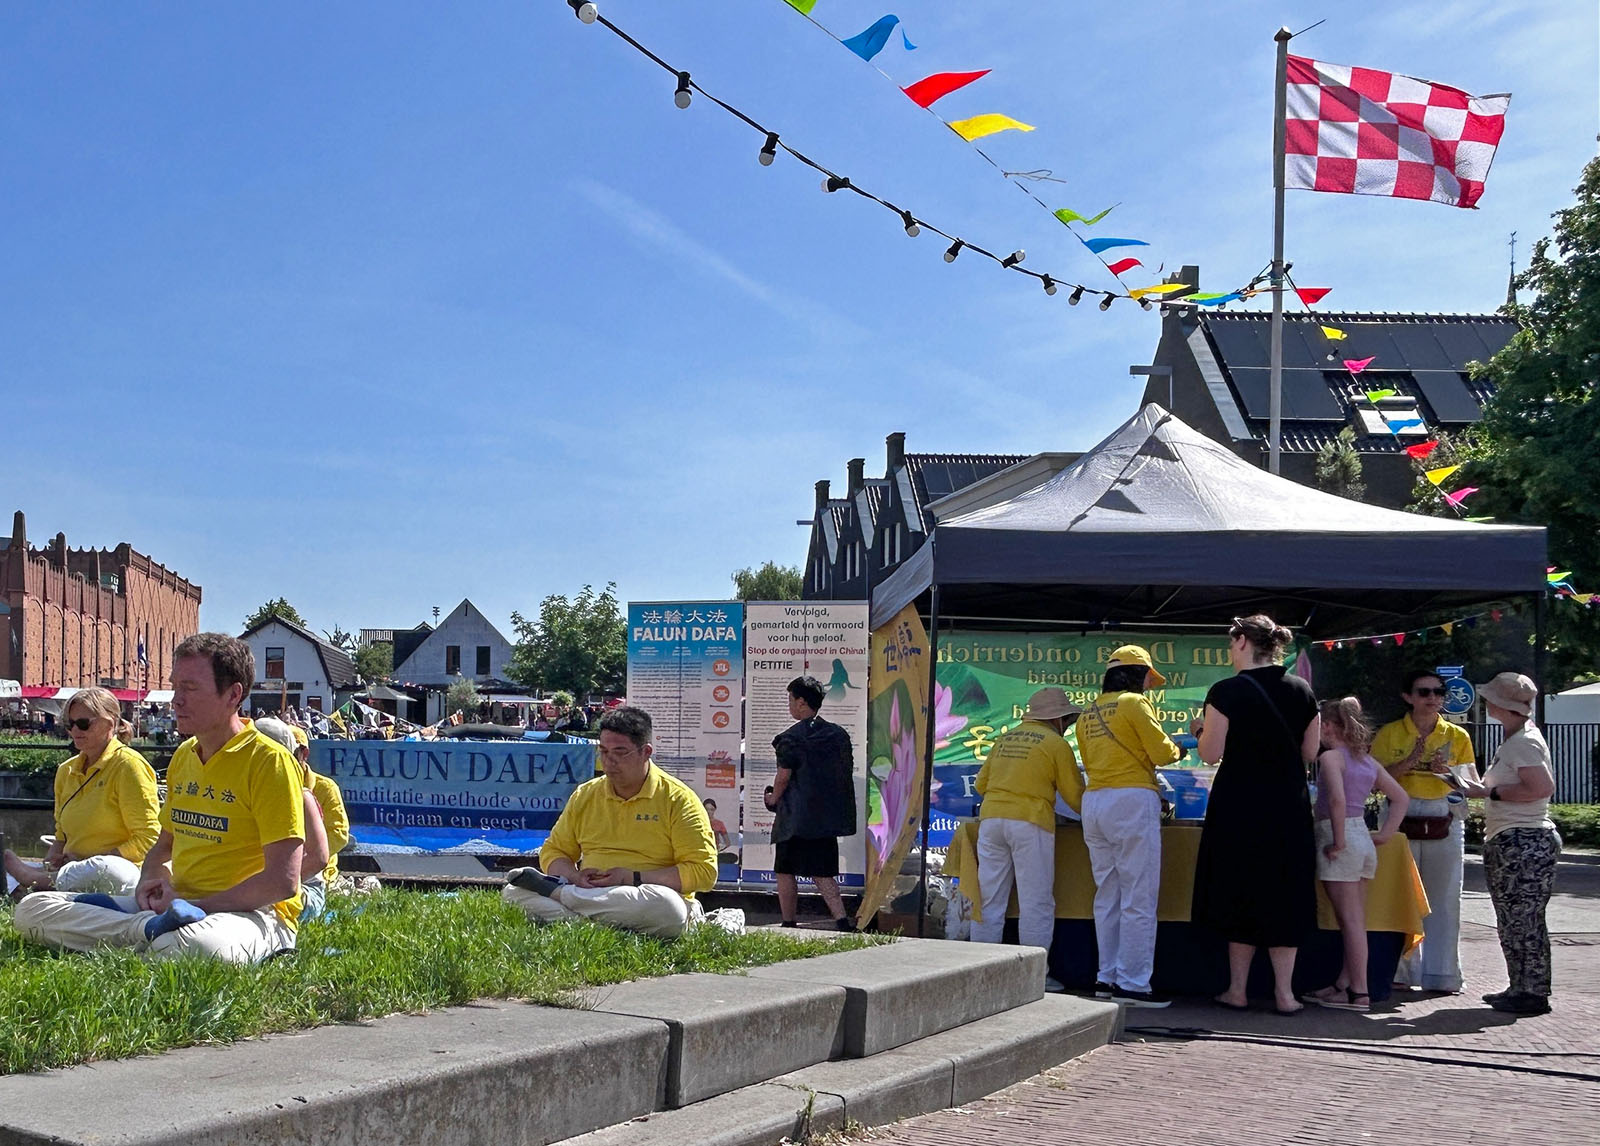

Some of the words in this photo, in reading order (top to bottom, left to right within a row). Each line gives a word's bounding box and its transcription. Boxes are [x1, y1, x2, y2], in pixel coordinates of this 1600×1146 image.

[641, 608, 728, 625] 法輪大法
[785, 607, 830, 618] Vervolgd,
[751, 620, 799, 631] gemarteld
[802, 622, 814, 630] en
[817, 620, 864, 630] vermoord
[633, 626, 687, 642] FALUN
[691, 626, 737, 642] DAFA
[767, 634, 789, 643] voor
[791, 633, 810, 642] hun
[813, 633, 846, 644] geloof.
[748, 646, 767, 656] Stop
[769, 646, 780, 655] de
[781, 646, 828, 657] orgaanroof
[829, 646, 838, 655] in
[839, 646, 866, 656] China!
[753, 660, 793, 670] PETITIE
[328, 747, 453, 781] FALUN
[467, 751, 578, 785] DAFA
[344, 786, 424, 805] meditatie
[431, 789, 510, 809] methode
[518, 796, 563, 810] voor
[199, 815, 225, 830] DAFA
[373, 807, 444, 827] lichaam
[450, 814, 473, 828] en
[480, 814, 528, 831] geest
